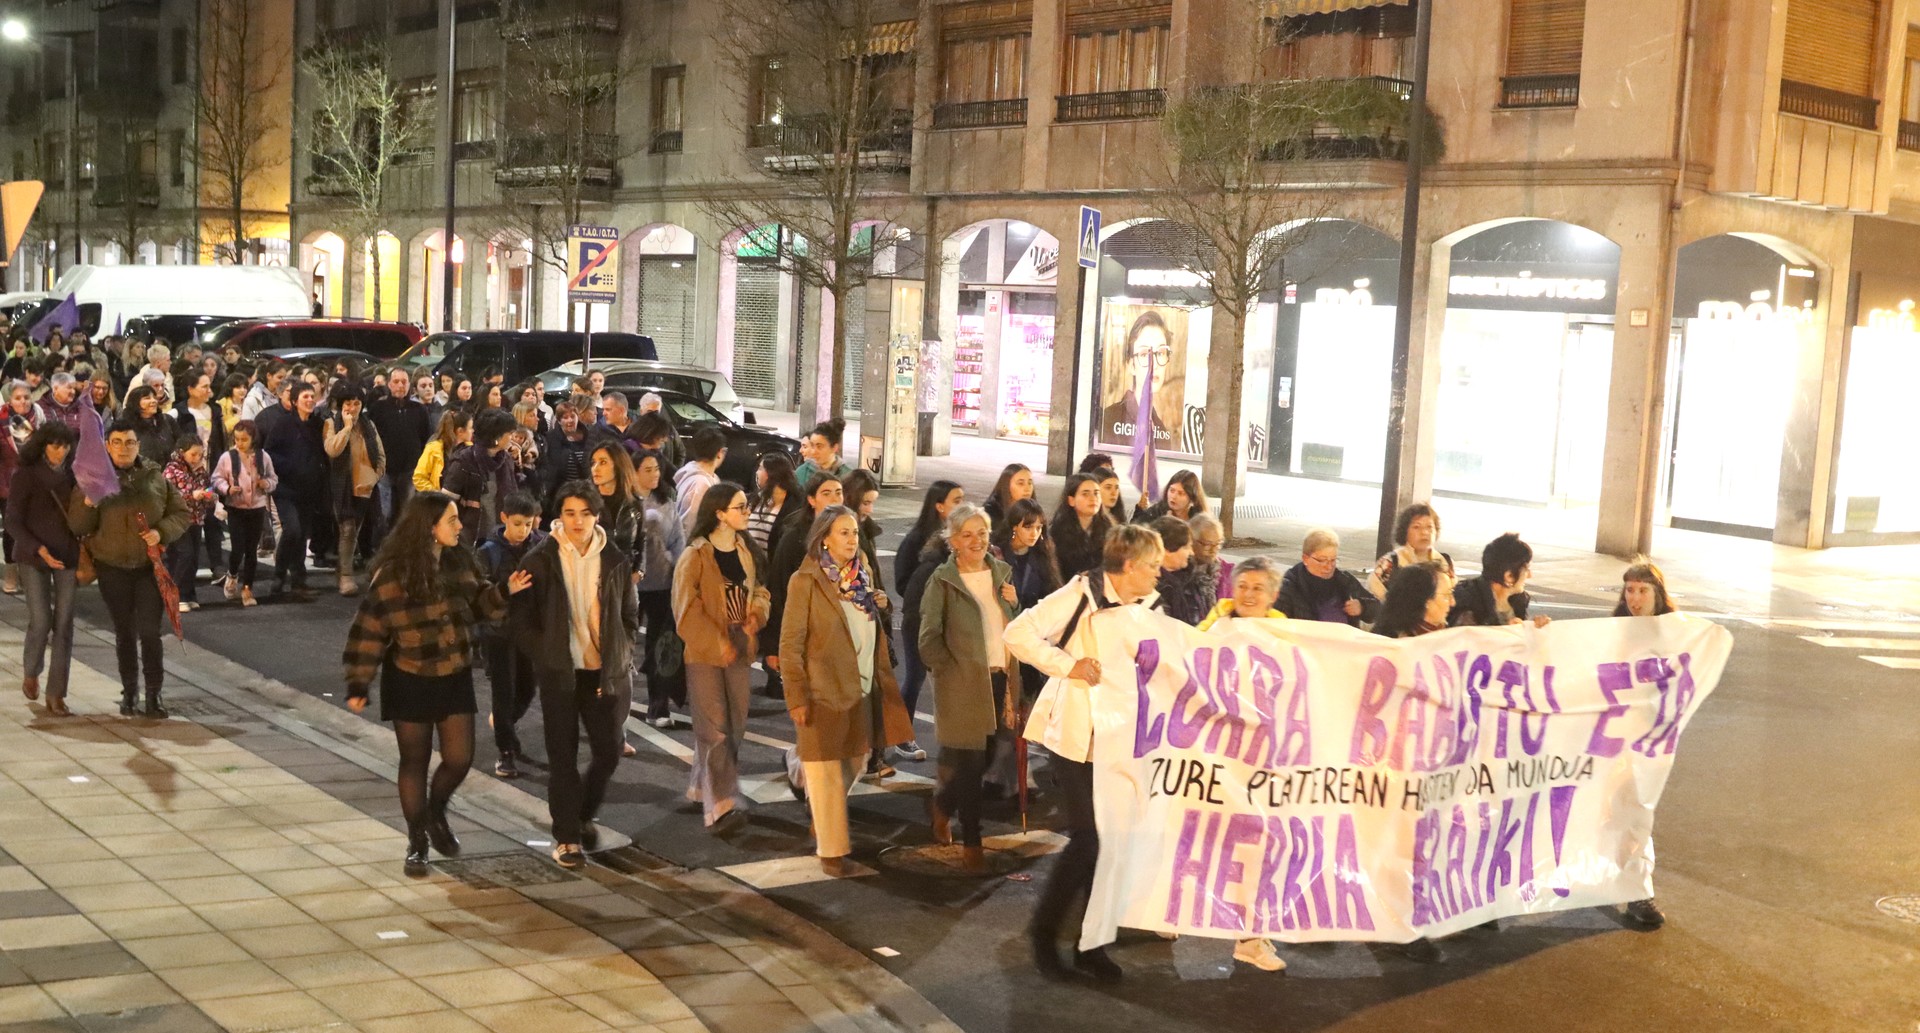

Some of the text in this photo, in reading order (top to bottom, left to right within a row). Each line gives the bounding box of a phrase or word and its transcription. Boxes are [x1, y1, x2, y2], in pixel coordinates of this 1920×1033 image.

[1133, 638, 1312, 769] LURRA
[1585, 652, 1696, 758] ETA
[1149, 758, 1225, 805] ZURE
[1247, 767, 1389, 809] PLATEREAN
[1507, 755, 1595, 789] MUNDUA
[1164, 808, 1376, 933] HERRIA
